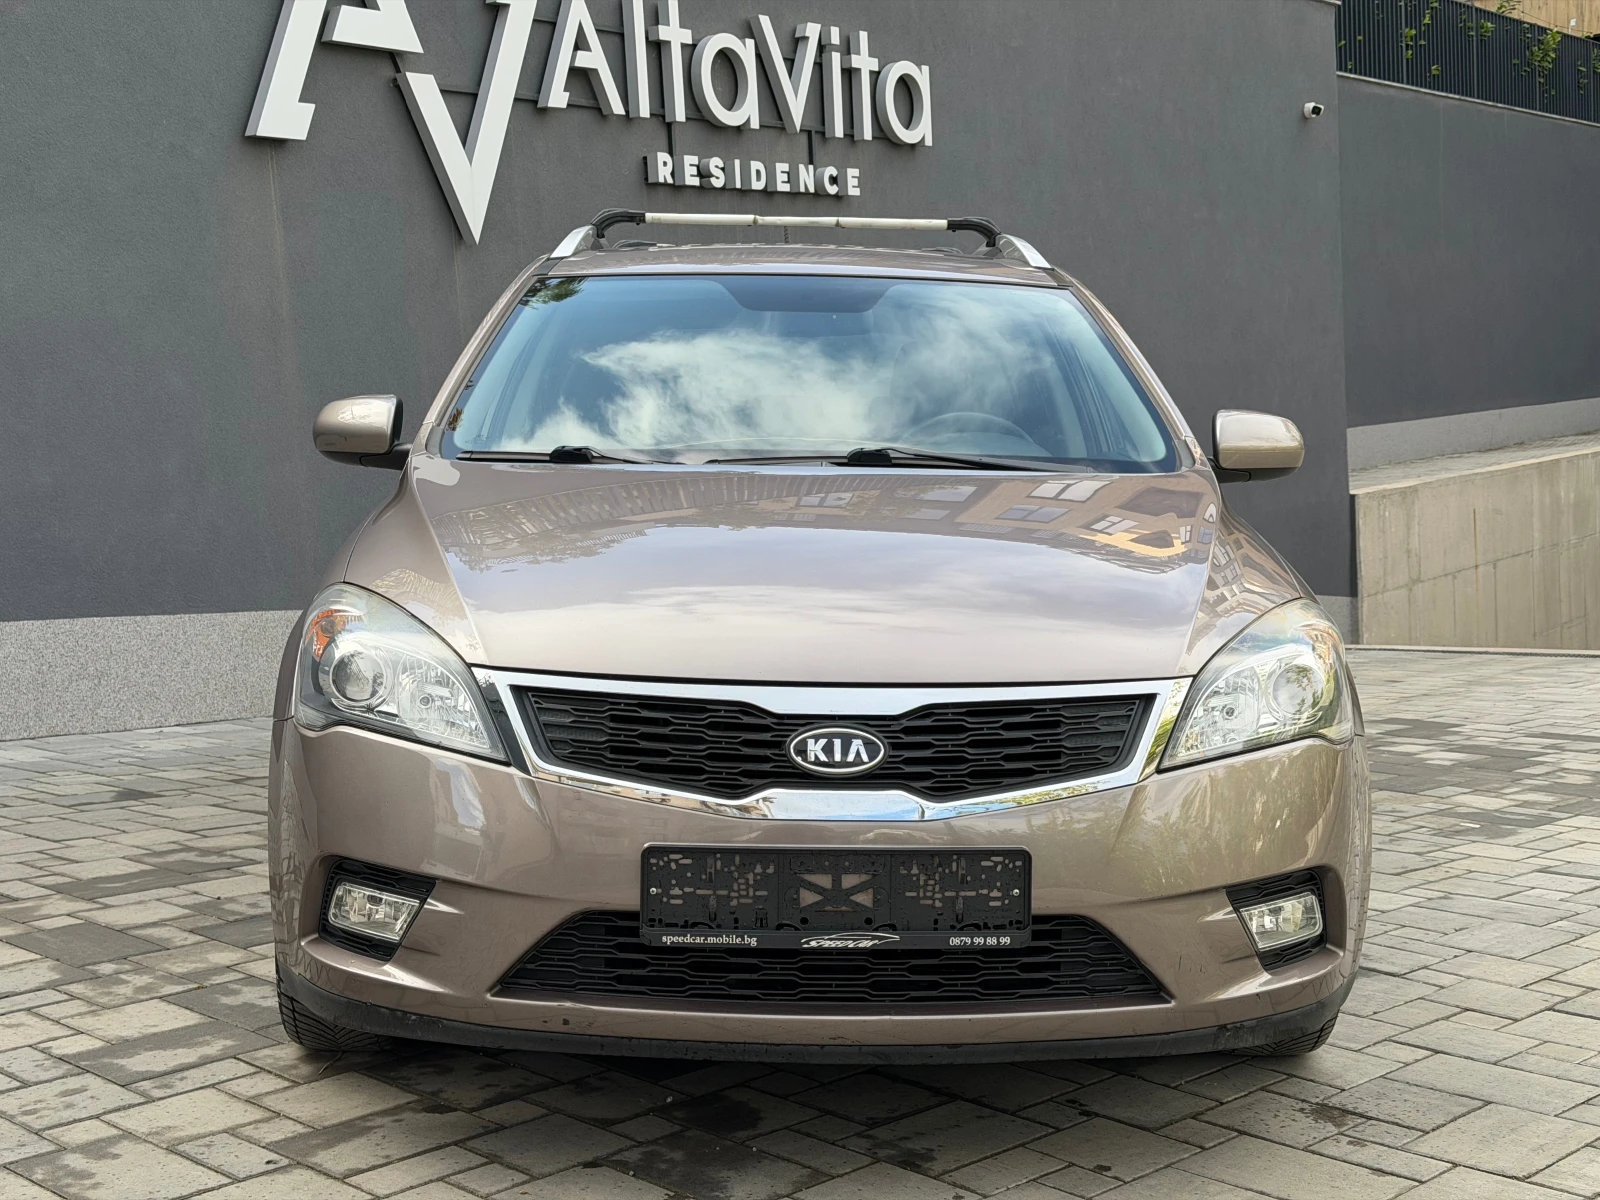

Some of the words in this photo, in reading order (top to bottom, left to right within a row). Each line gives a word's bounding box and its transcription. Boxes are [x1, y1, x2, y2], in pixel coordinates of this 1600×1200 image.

[538, 0, 932, 146] AltaVita
[648, 152, 861, 196] RESIDENCE
[806, 738, 869, 762] KIA
[662, 934, 758, 947] speedcar.mobile.bg
[949, 936, 971, 946] 0879
[973, 936, 985, 946] 99
[986, 936, 998, 946] 88
[999, 936, 1011, 946] 99
